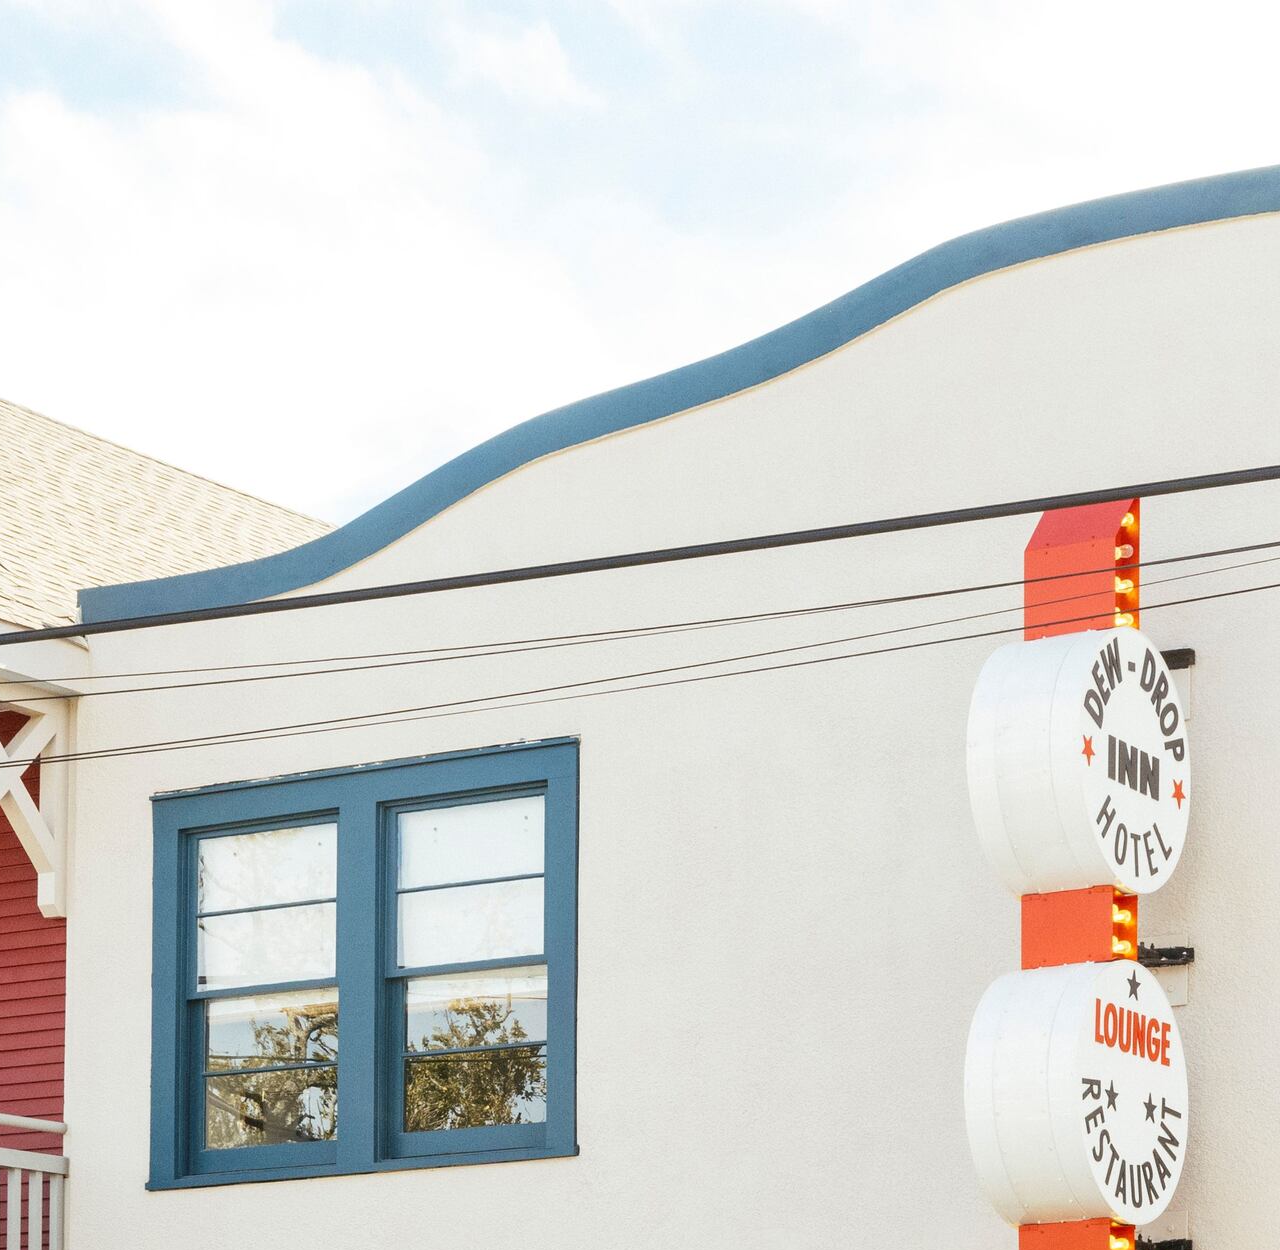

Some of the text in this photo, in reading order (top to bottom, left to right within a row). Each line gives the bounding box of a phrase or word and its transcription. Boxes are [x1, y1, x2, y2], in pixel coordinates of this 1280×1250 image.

[1107, 734, 1160, 802] INN
[1096, 794, 1173, 878] HOTEL
[1094, 997, 1171, 1067] LOUNGE
[1081, 1077, 1183, 1209] RESTAURANT
